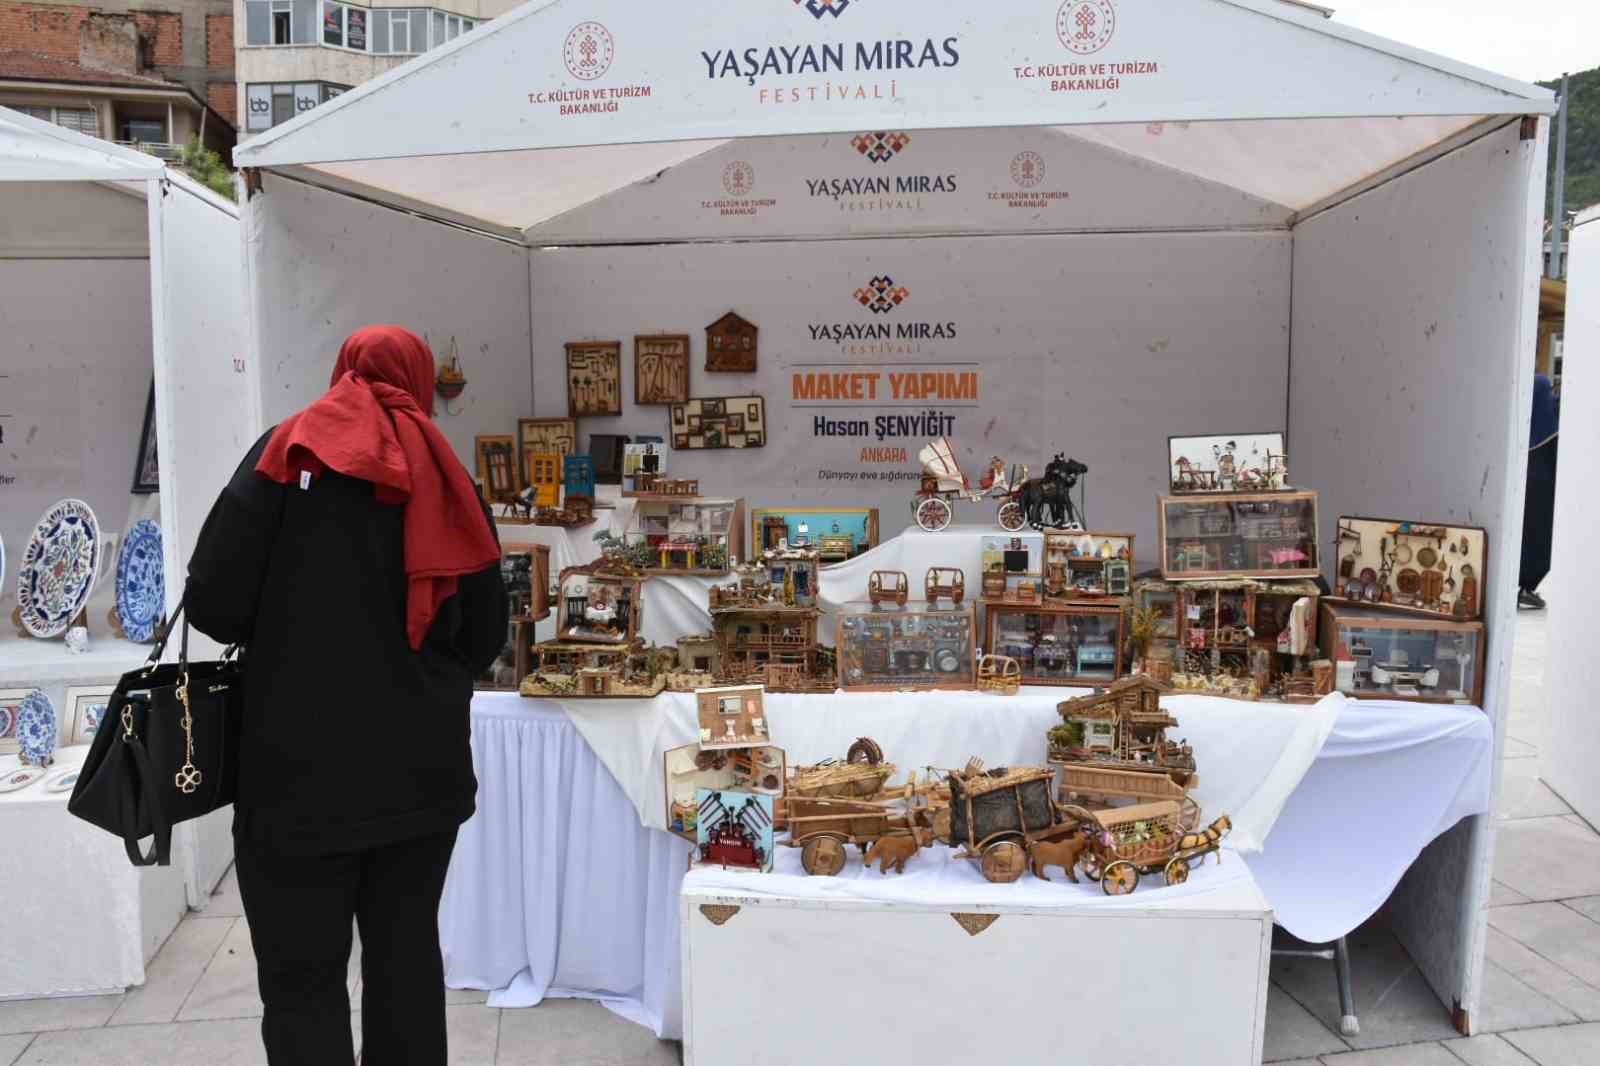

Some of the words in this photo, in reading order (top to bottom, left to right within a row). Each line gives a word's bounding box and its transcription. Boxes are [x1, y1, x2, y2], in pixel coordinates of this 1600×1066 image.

[701, 43, 843, 85] YAŞAYAN
[856, 37, 960, 70] MİRAS
[1014, 66, 1035, 79] T.C.
[1038, 62, 1086, 77] KÜLTÜR
[1090, 63, 1105, 75] VE
[1107, 60, 1158, 74] TURİZM
[528, 92, 546, 104] T.C.
[548, 88, 590, 103] KÜLTÜR
[592, 88, 607, 99] VE
[608, 83, 651, 98] TURİZM
[759, 79, 897, 104] FESTİVALİ
[1051, 76, 1119, 91] BAKANLIĞI
[559, 99, 618, 115] BAKANLIĞI
[806, 177, 890, 200] YAŞAYAN
[808, 323, 890, 343] YAŞAYAN
[792, 372, 880, 400] MAKET
[888, 371, 977, 400] YAPIMI
[814, 415, 869, 436] Hasan
[875, 411, 955, 441] ŞENYİĞİT
[860, 447, 908, 463] ANKARA
[860, 471, 878, 480] eve
